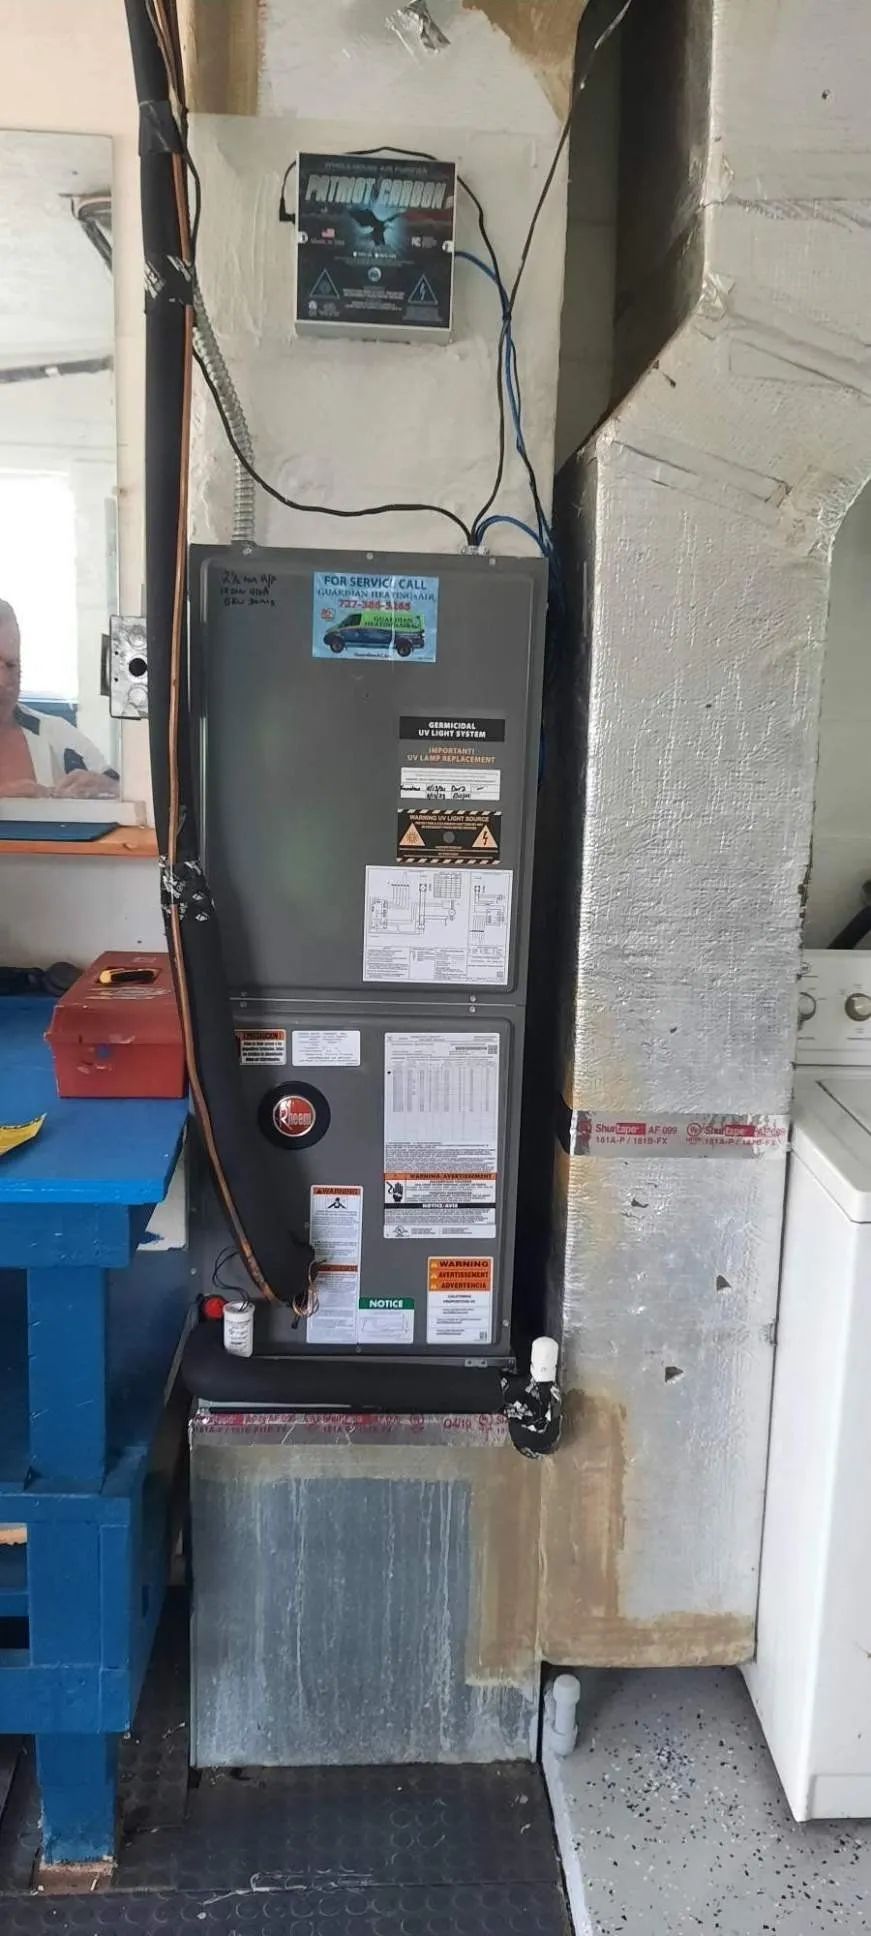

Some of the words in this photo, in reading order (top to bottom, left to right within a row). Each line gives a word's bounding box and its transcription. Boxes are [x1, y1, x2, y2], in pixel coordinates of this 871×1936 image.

[305, 174, 376, 204] PATRIOT
[378, 178, 446, 209] CARBON
[324, 575, 347, 587] FOR
[350, 577, 395, 589] SERVIC
[399, 580, 427, 591] CALL
[318, 589, 369, 600] GUARDIAN
[428, 722, 476, 730] GERMICIDAL
[456, 731, 486, 739] SYSTEM
[442, 756, 496, 764] REPLACEMENT
[279, 1100, 312, 1130] Rheem
[648, 1125, 661, 1135] AF
[439, 1260, 489, 1268] WARNING
[369, 1299, 403, 1308] NOTICE
